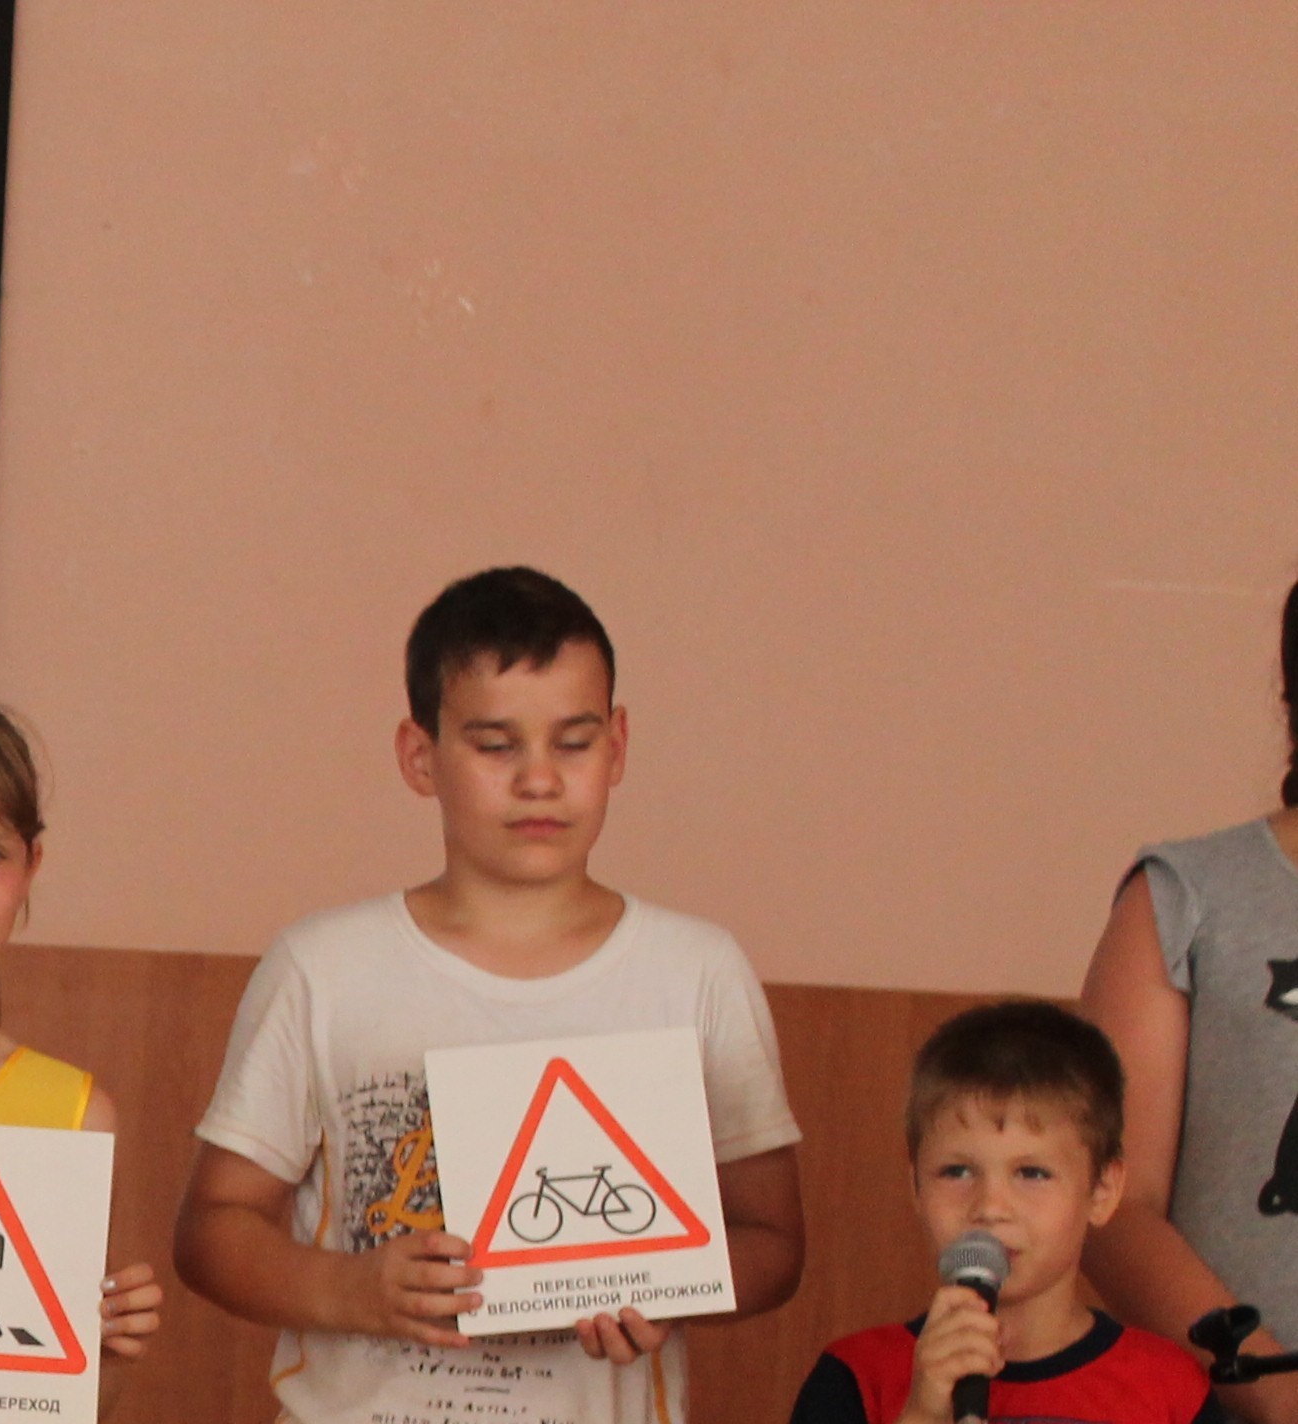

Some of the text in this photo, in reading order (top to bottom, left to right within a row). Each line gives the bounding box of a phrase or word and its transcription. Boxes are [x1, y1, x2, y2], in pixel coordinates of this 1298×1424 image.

[533, 1271, 652, 1294] ПЕРЕСЕЧЕНИЕ
[487, 1292, 622, 1316] ВЕЛОСИПЕДНОЙ
[630, 1281, 725, 1305] ДОРОЖКОЙ
